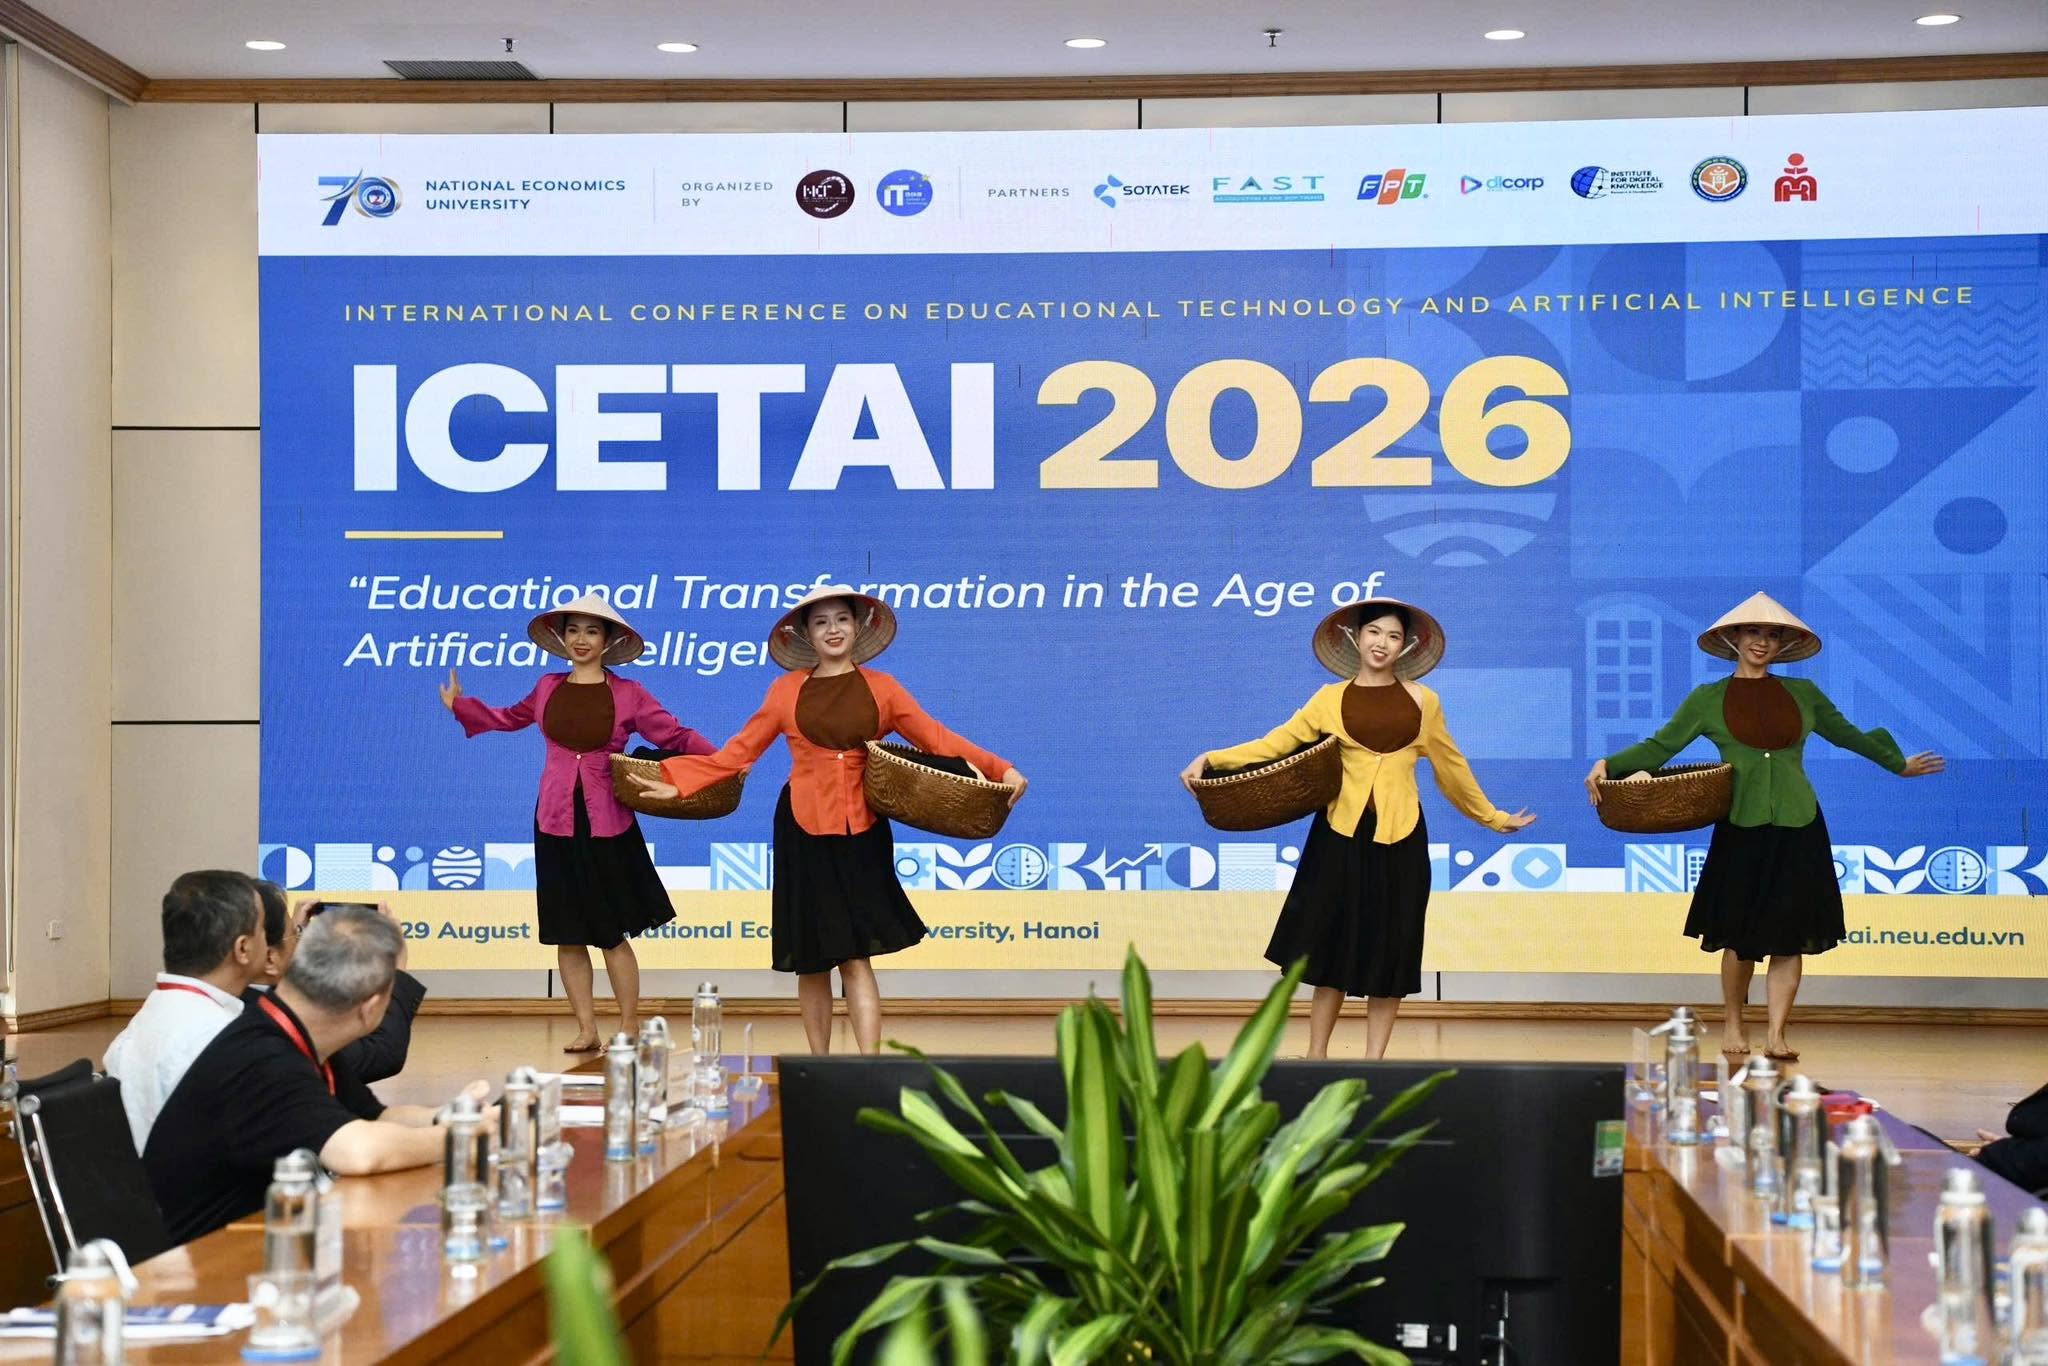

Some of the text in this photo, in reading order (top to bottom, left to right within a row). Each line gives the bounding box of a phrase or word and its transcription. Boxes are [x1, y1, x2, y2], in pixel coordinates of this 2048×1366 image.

[425, 180, 626, 191] NATIONAL ECONOMICS
[681, 182, 774, 192] ORGANIZED
[1212, 176, 1325, 191] FAST
[988, 187, 1070, 198] PARTNERS
[425, 199, 531, 210] UNIVERSITY
[681, 197, 701, 207] BY
[345, 286, 1973, 322] INTERNATIONAL CONFERENCE ON EDUCATIONAL TECHNOLOGY AND ARTIFICIAL INTELLIGENCE
[354, 355, 1571, 492] ICETAI 2026
[1062, 574, 1104, 608] in
[1120, 572, 1199, 608] the
[1211, 573, 1315, 617] Age
[1331, 570, 1385, 608] of
[400, 921, 531, 944] 29 August
[634, 920, 732, 939] ational
[927, 921, 1015, 944] versity,
[1023, 921, 1099, 940] Hanoi
[1842, 926, 2025, 946] ai.neu.edu.vn
